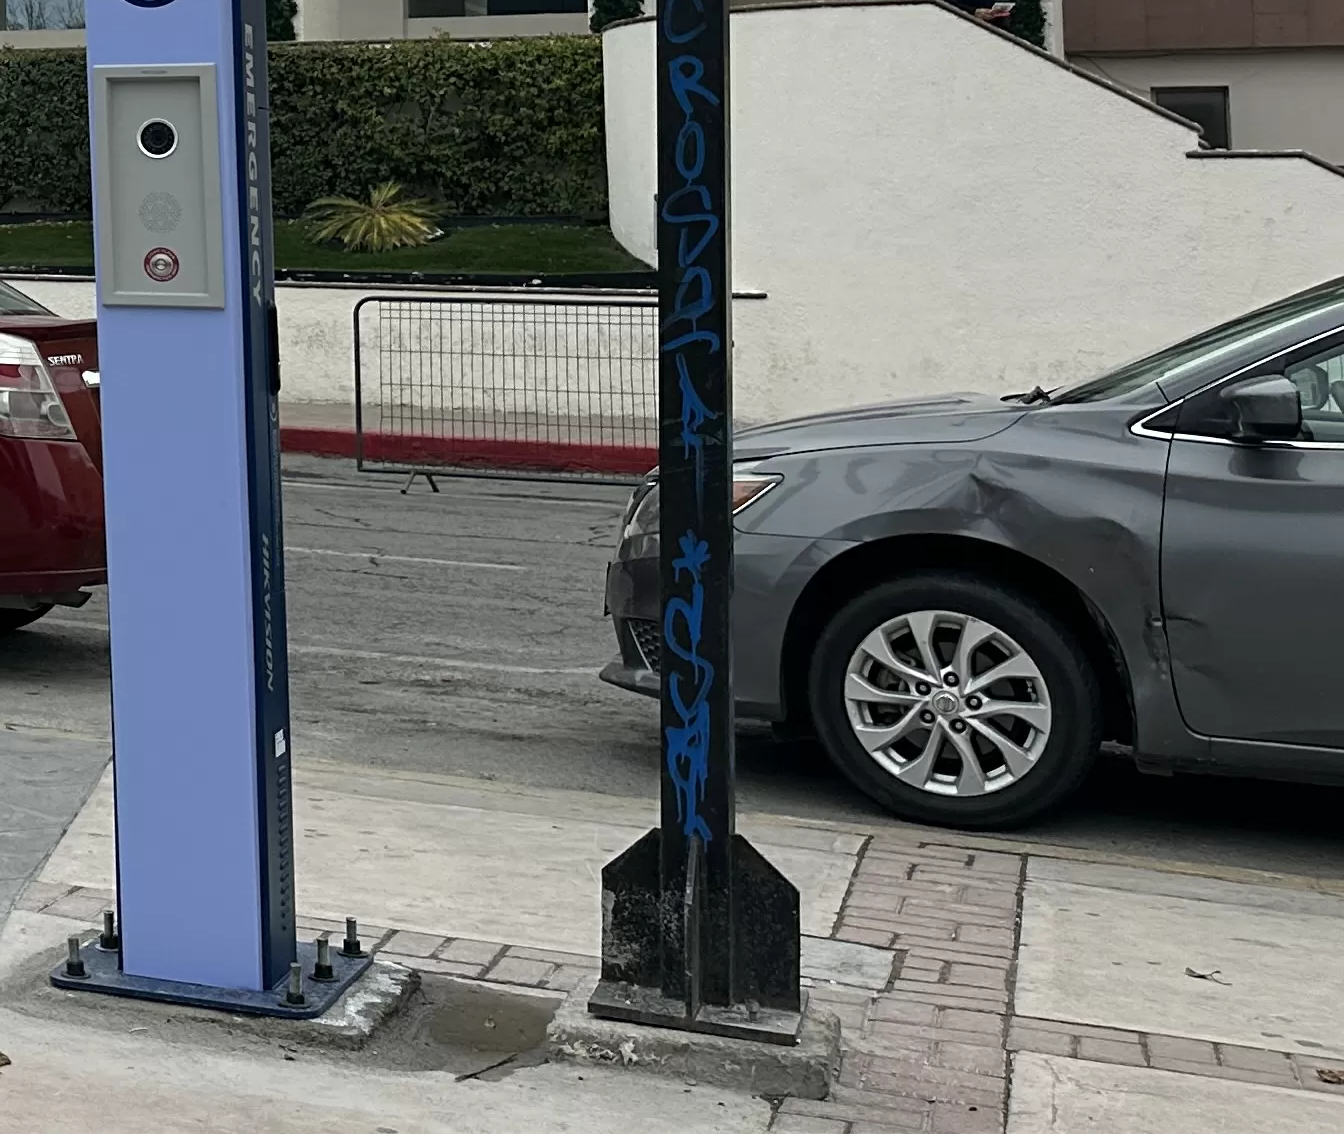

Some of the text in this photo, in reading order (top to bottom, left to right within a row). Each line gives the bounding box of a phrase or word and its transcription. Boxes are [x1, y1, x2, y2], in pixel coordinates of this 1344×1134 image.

[244, 23, 262, 307] EMERGENCY
[47, 353, 84, 366] SENTRA
[261, 533, 275, 693] HIKVISION
